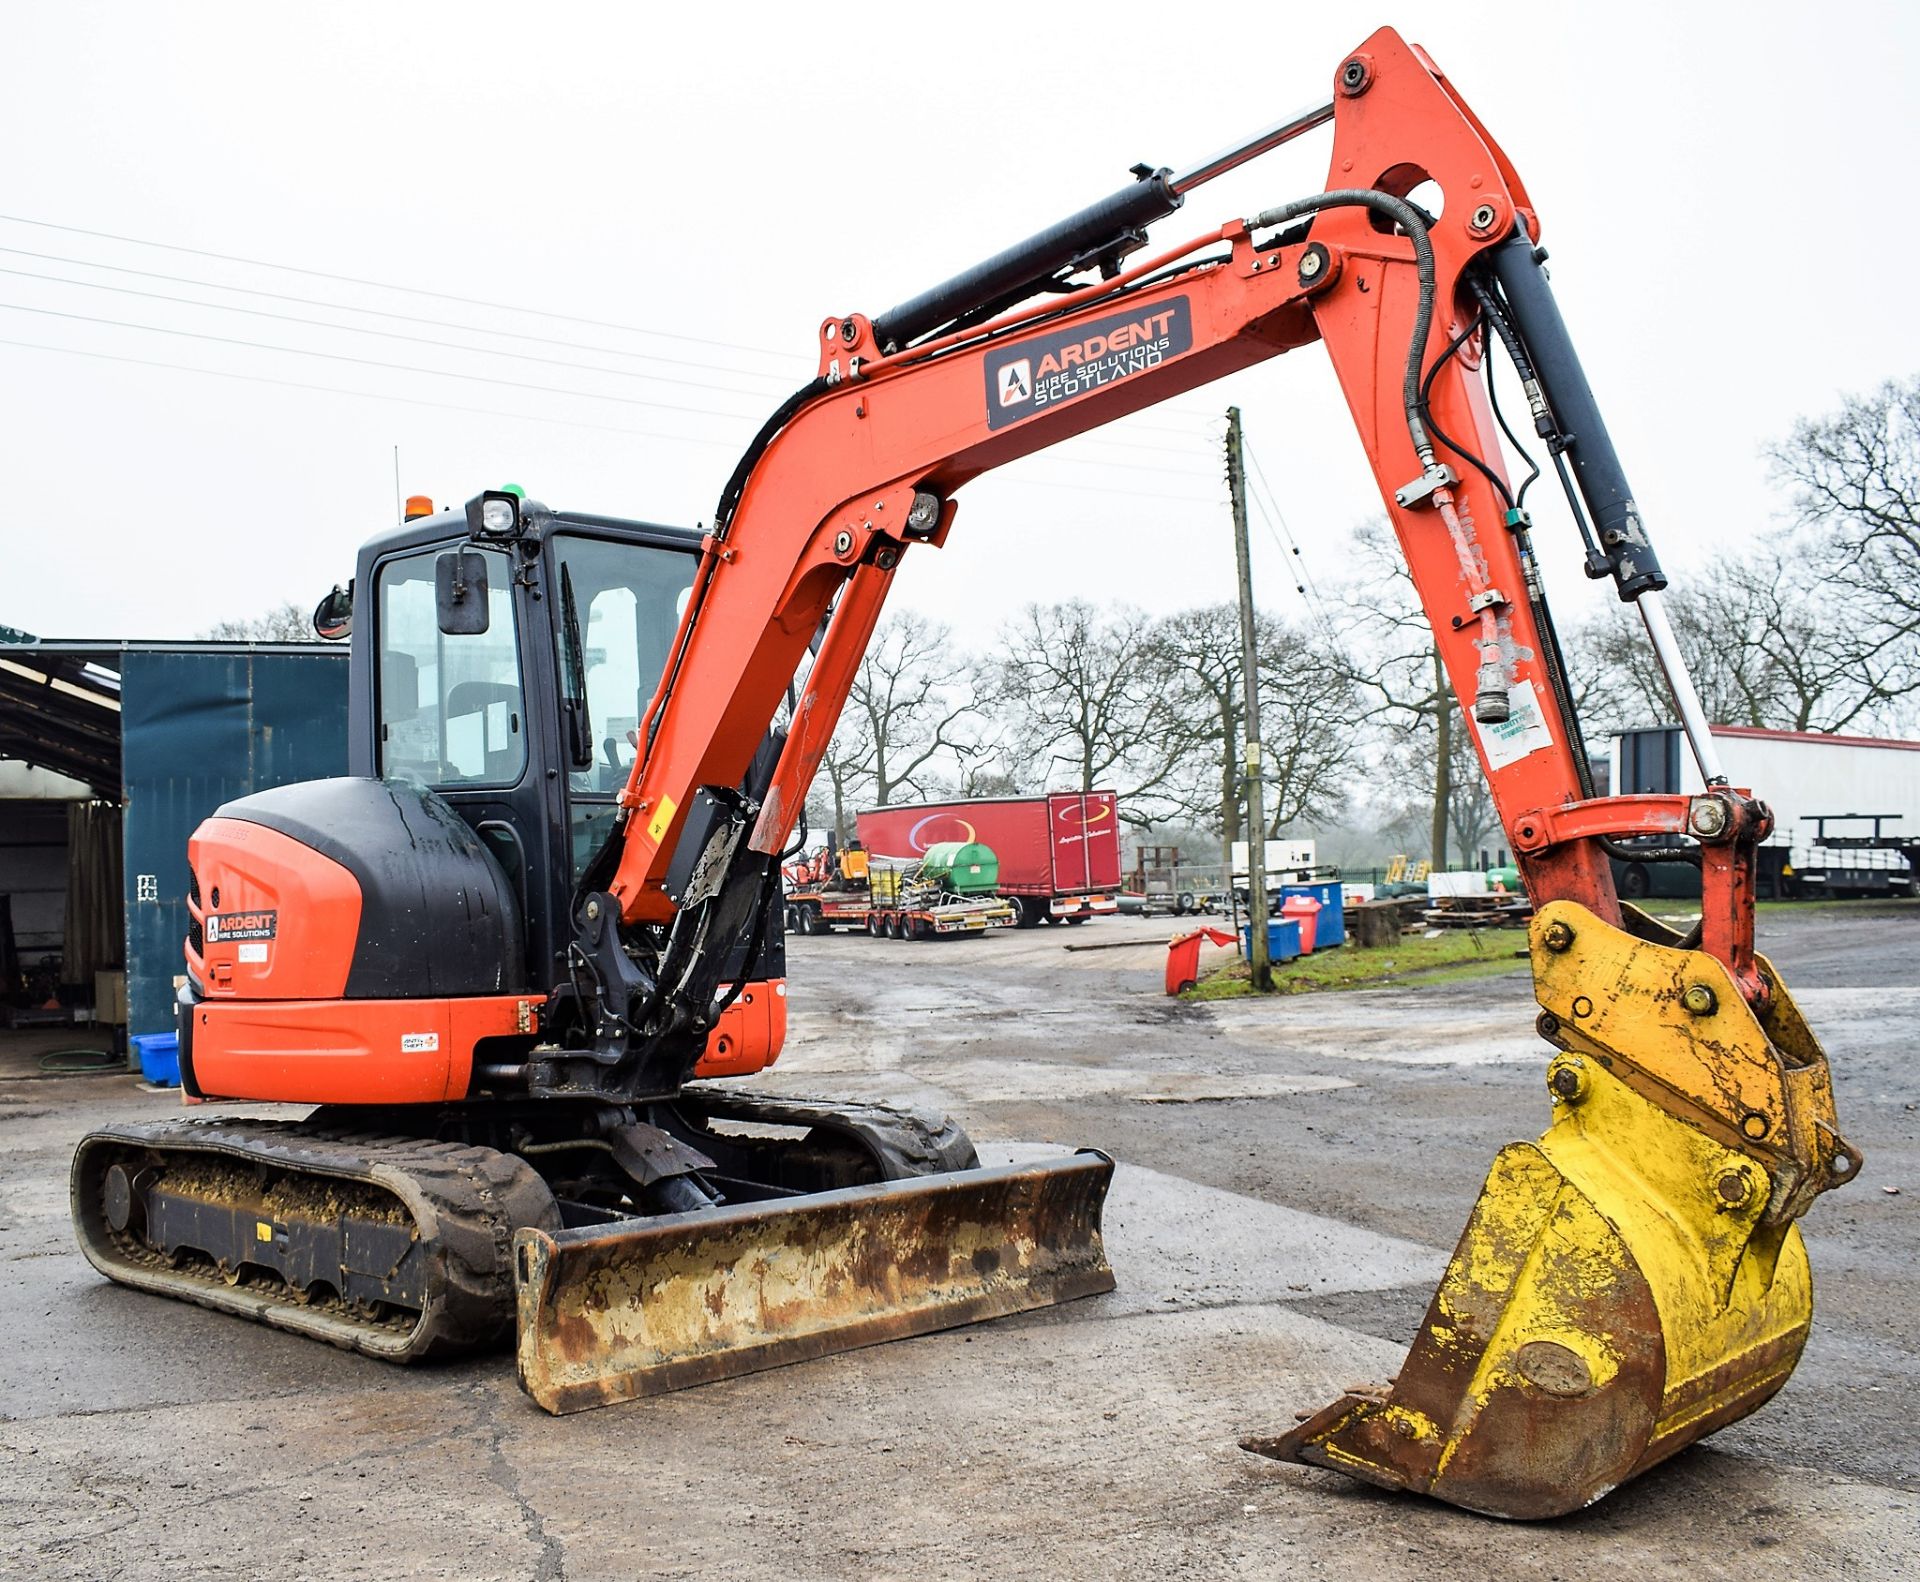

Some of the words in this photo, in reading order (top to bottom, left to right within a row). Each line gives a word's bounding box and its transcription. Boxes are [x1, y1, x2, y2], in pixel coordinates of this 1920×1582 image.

[1035, 372, 1070, 393] HIRE
[1076, 337, 1170, 379] SOLUTIONS
[1036, 309, 1175, 379] ARDENT
[1034, 351, 1163, 406] SCOTLAND
[218, 931, 231, 939] HIRE
[232, 929, 271, 939] SOLUTIONS
[219, 914, 273, 931] ARDENT
